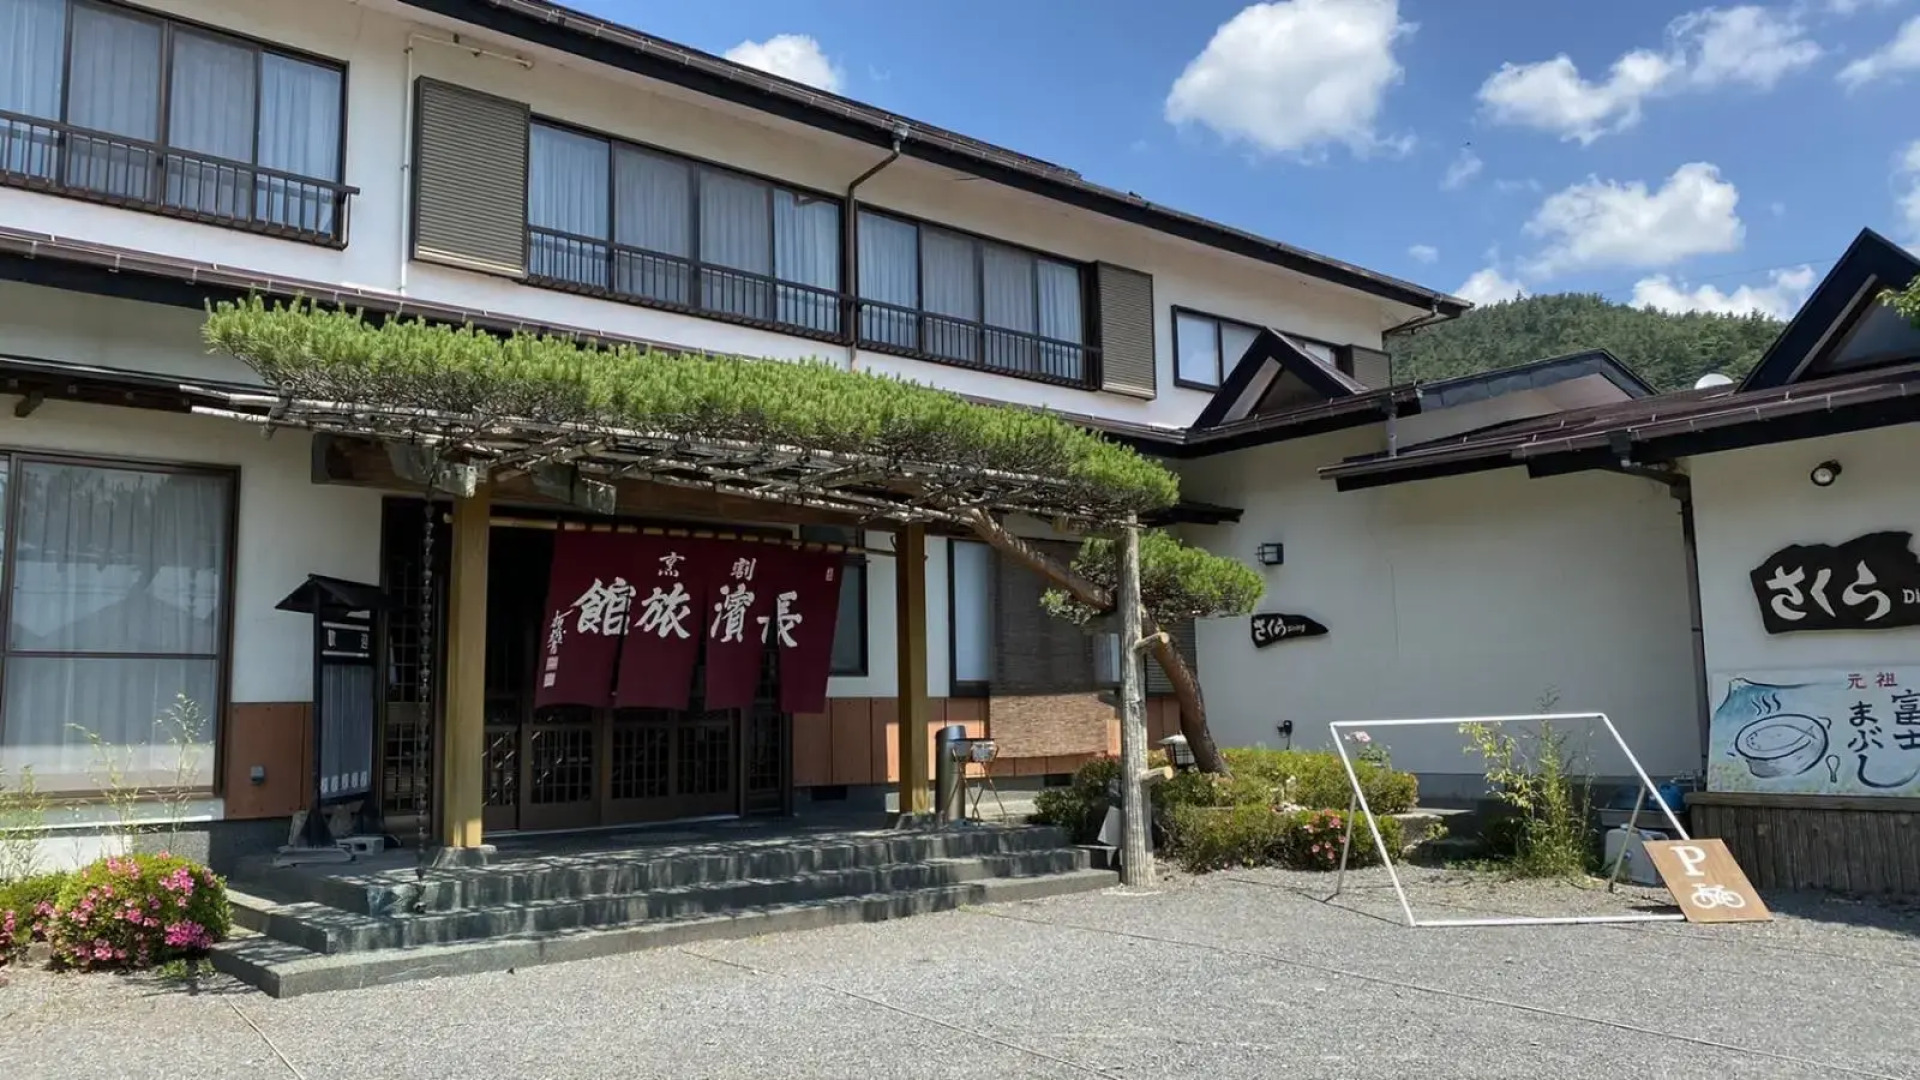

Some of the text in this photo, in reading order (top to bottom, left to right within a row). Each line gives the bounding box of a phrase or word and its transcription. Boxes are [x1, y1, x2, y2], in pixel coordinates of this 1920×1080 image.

[1766, 560, 1891, 621] さくら
[1253, 617, 1287, 641] さくら
[1847, 672, 1899, 690] 元祖
[1891, 689, 1920, 751] 富士
[1847, 701, 1920, 788] まぶし
[1669, 845, 1706, 876] P
